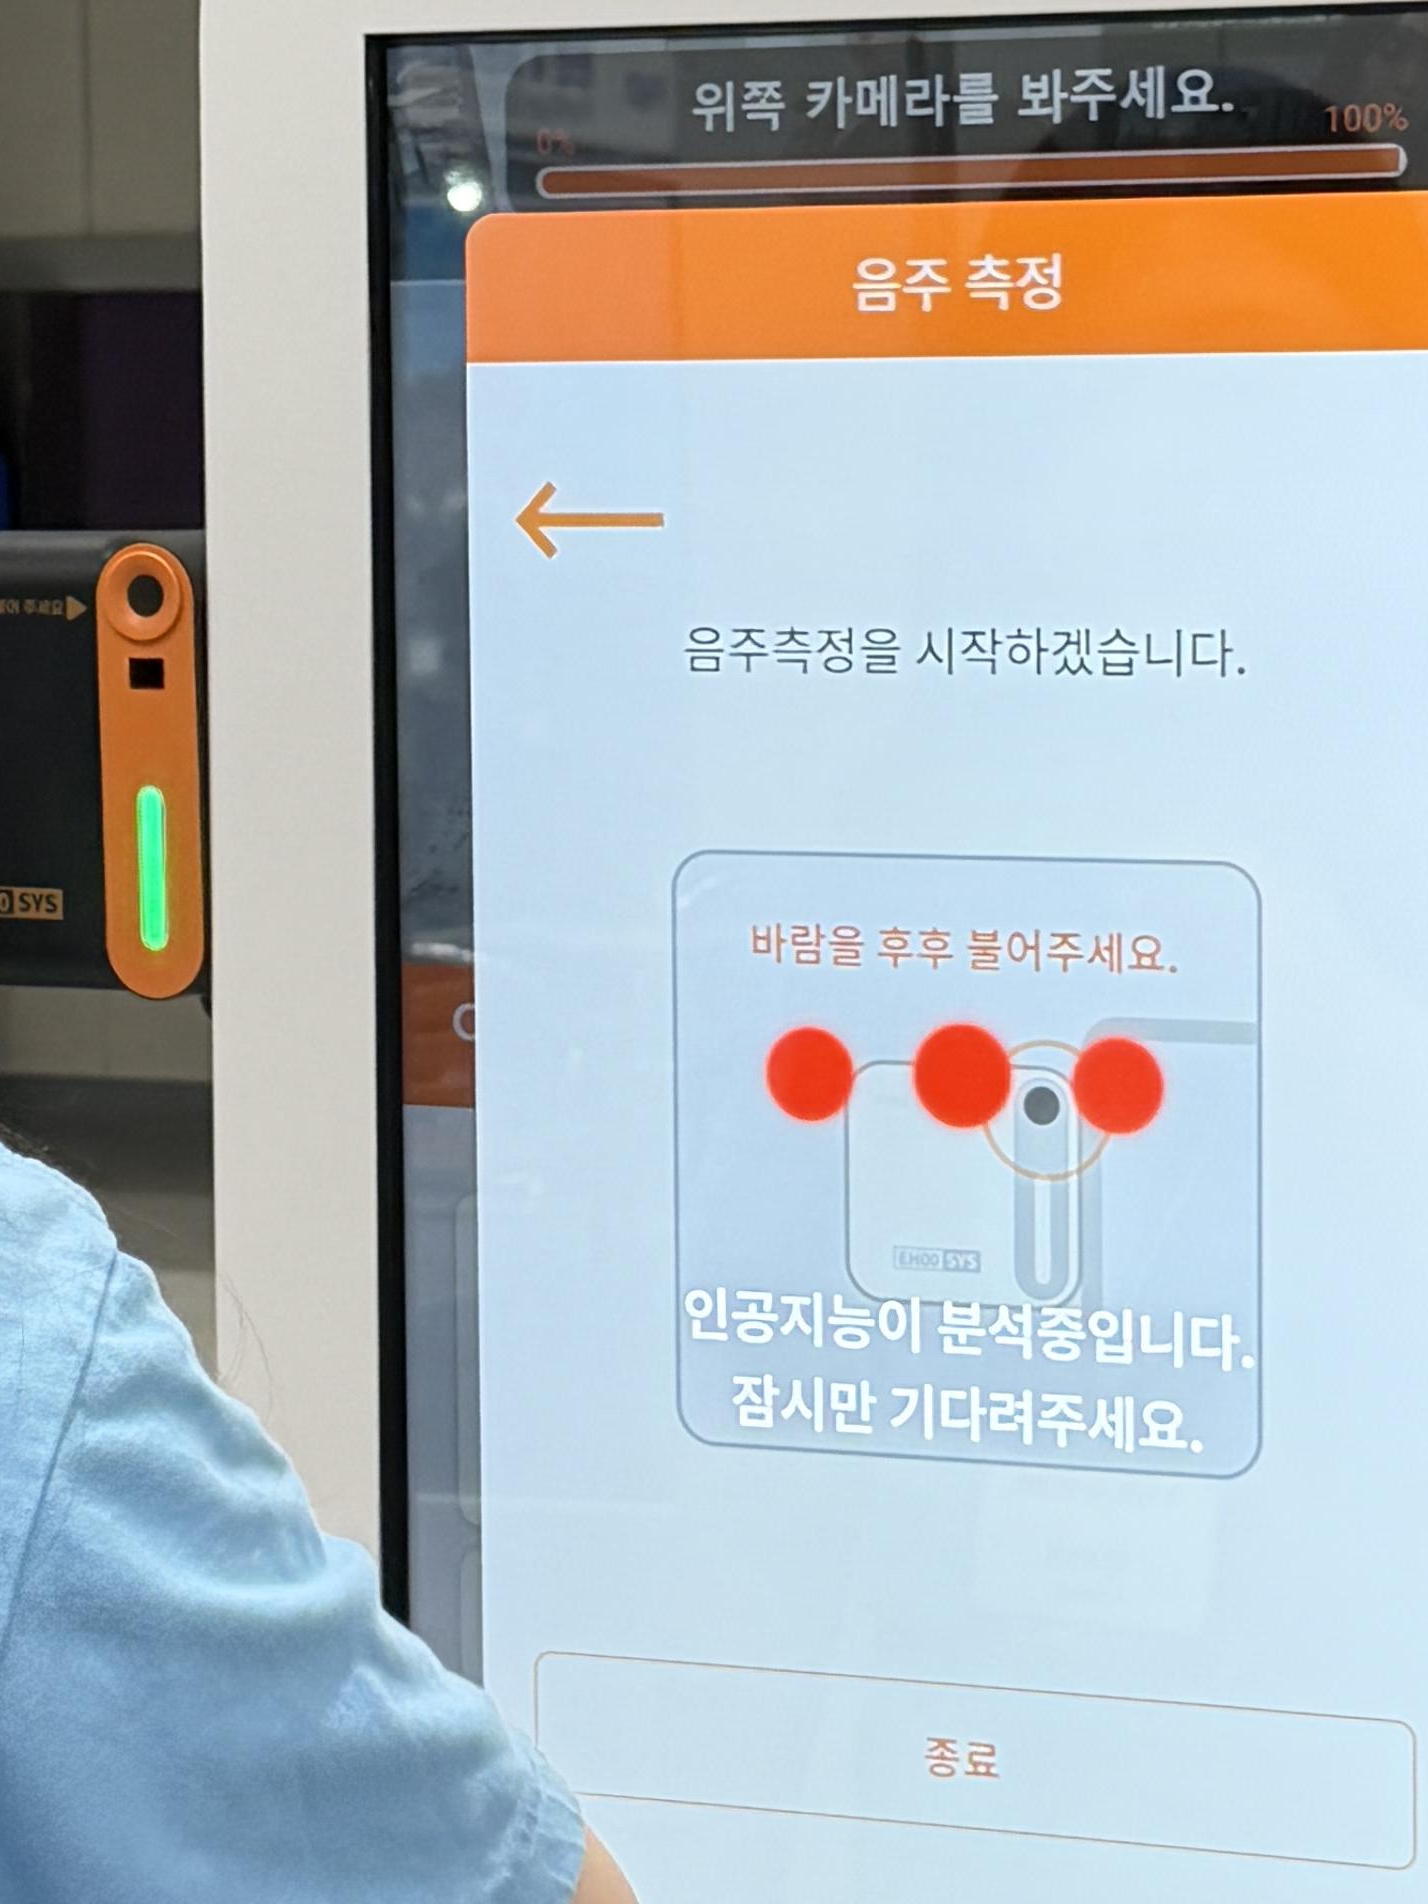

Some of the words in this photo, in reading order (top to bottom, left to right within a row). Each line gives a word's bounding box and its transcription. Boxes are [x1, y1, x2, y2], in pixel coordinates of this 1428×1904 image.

[692, 79, 788, 133] 위쪽
[806, 73, 999, 129] 카메라를
[1017, 66, 1235, 126] 봐주세요.
[1322, 103, 1409, 136] 100%
[851, 256, 950, 314] 음주
[964, 252, 1066, 311] 측정
[683, 626, 902, 675] 음주측정을
[915, 626, 1248, 678] 시작하겠습니다.
[18, 890, 60, 915] SYS
[750, 923, 865, 967] 바람을
[876, 926, 955, 968] 후후
[966, 929, 1179, 974] 불어주세요.
[946, 1252, 978, 1269] SYS
[683, 1286, 922, 1355] 인공지능이
[936, 1298, 1256, 1373] 분석중입니다.
[731, 1372, 877, 1435] 잠시만
[889, 1384, 1205, 1455] 기다려주세요.
[924, 1735, 1001, 1781] 종료
